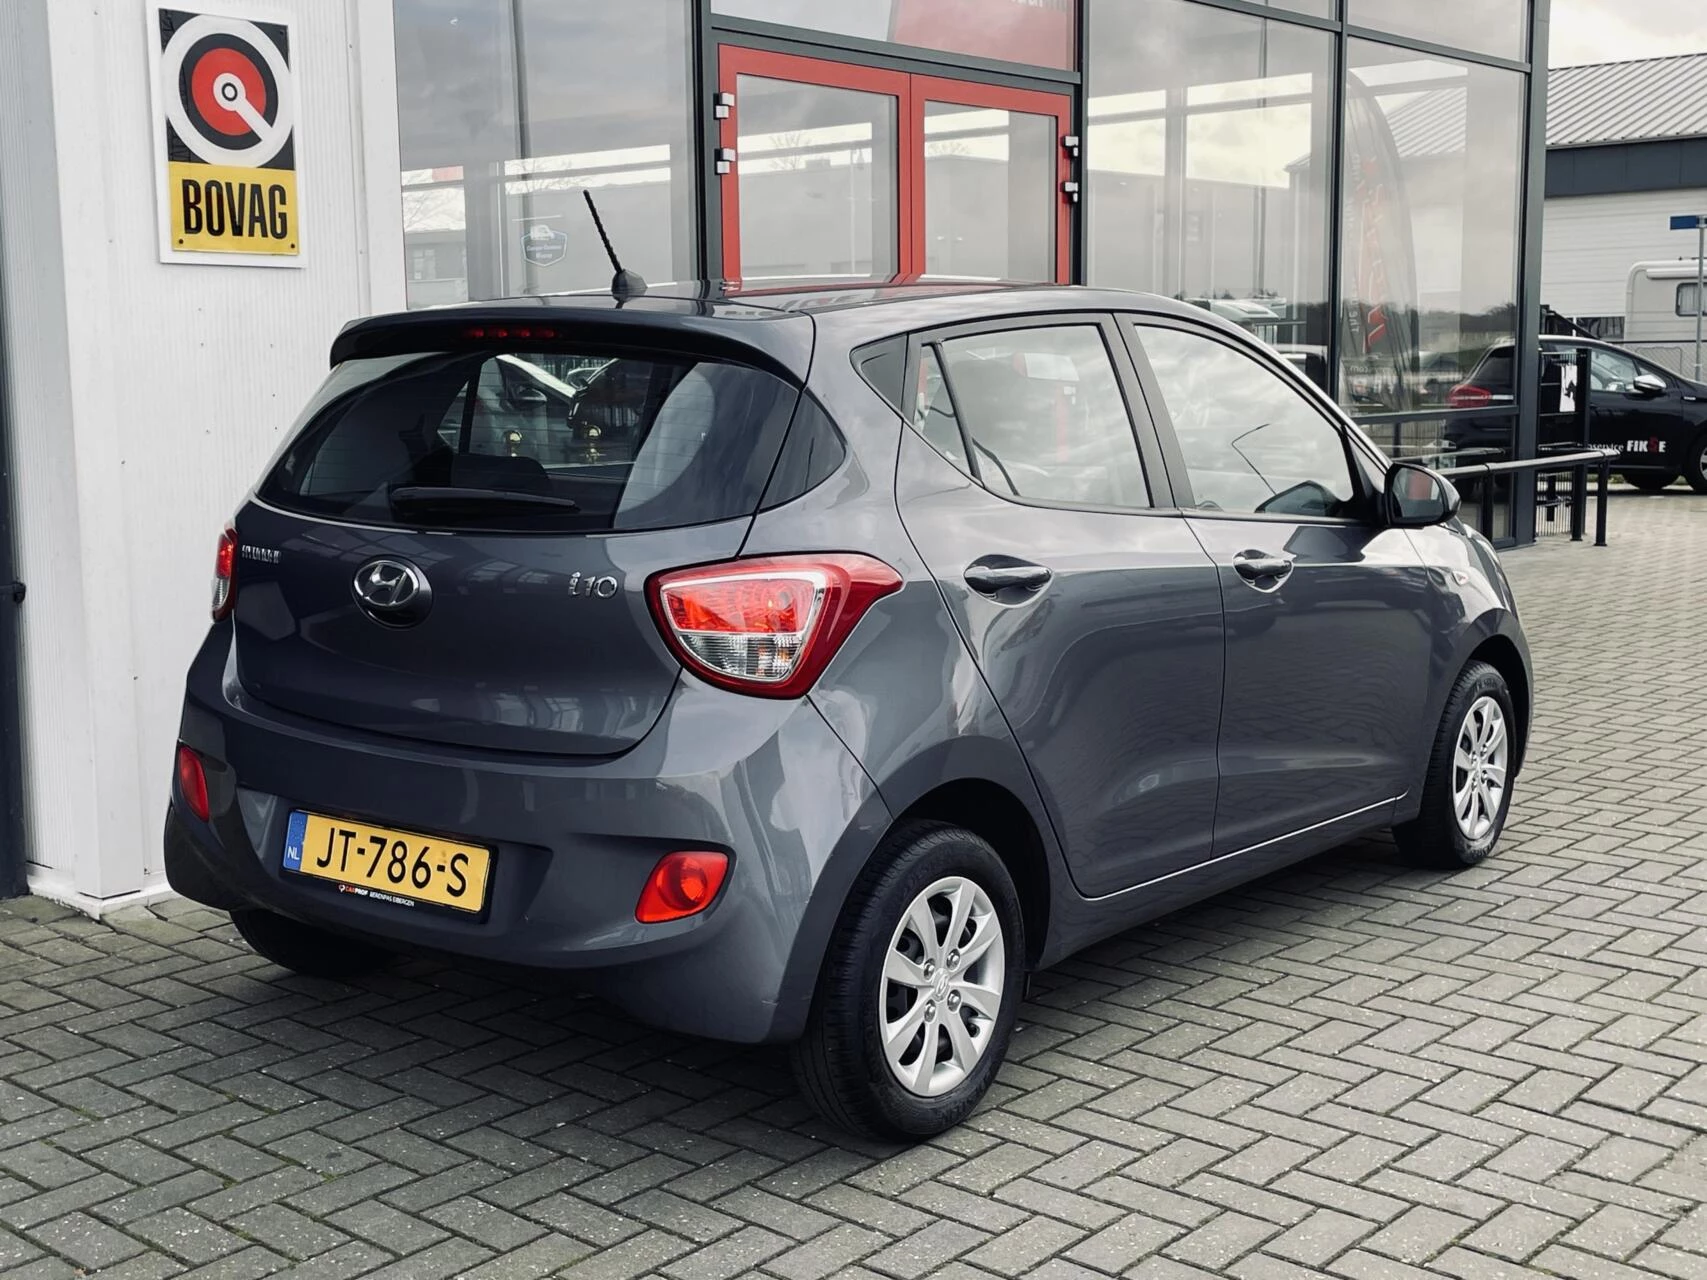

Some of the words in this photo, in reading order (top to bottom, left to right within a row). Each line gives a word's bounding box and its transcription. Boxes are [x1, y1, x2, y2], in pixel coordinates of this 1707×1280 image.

[182, 179, 288, 240] BOVAG
[568, 571, 618, 597] i10
[287, 846, 300, 861] NL
[316, 827, 469, 897] JT-786-S
